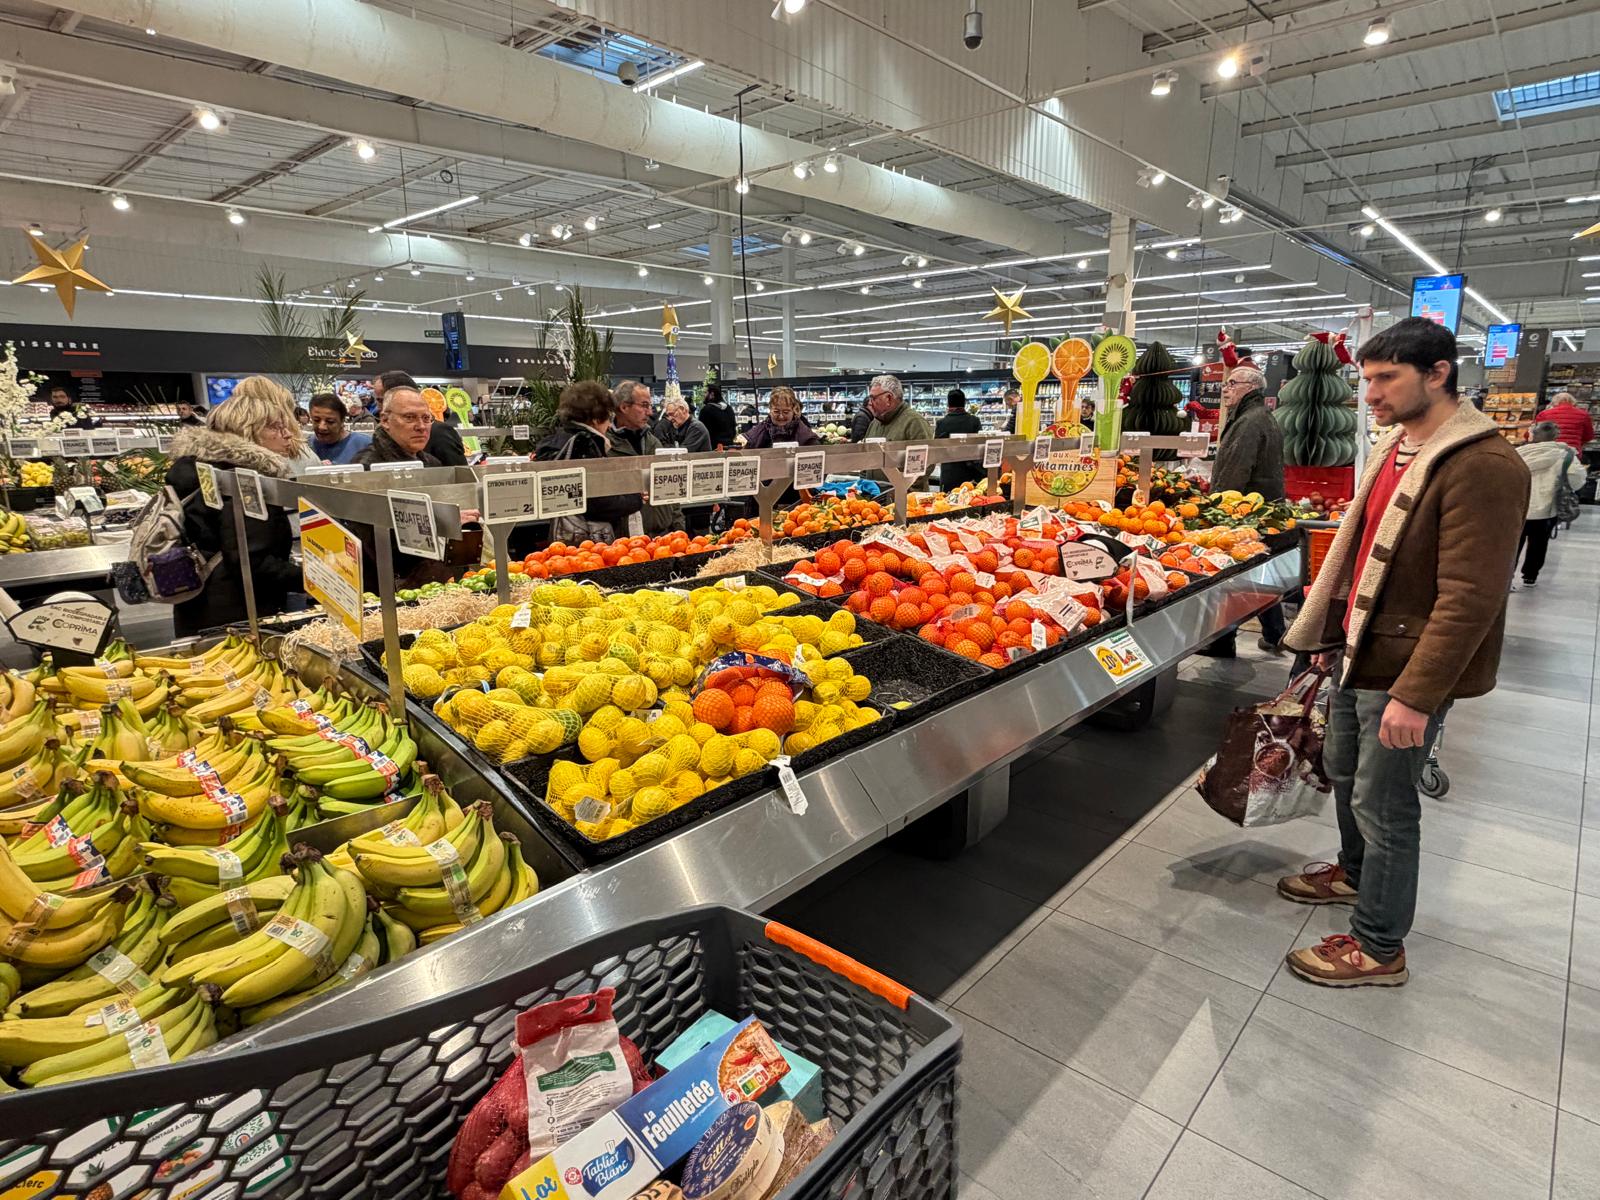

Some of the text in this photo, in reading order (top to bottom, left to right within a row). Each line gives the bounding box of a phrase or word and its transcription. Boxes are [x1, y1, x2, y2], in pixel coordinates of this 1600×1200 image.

[729, 468, 757, 477] ESPAGNE
[797, 463, 822, 472] ESPAGNE
[1034, 460, 1093, 472] Vitamines
[654, 474, 687, 485] ESPAGNE
[542, 482, 582, 496] ESPAGNE
[641, 1079, 715, 1150] Feuilletée
[643, 1110, 657, 1123] La
[583, 1150, 619, 1180] Tablier
[595, 1160, 629, 1187] Blanc
[519, 1176, 558, 1200] Lot
